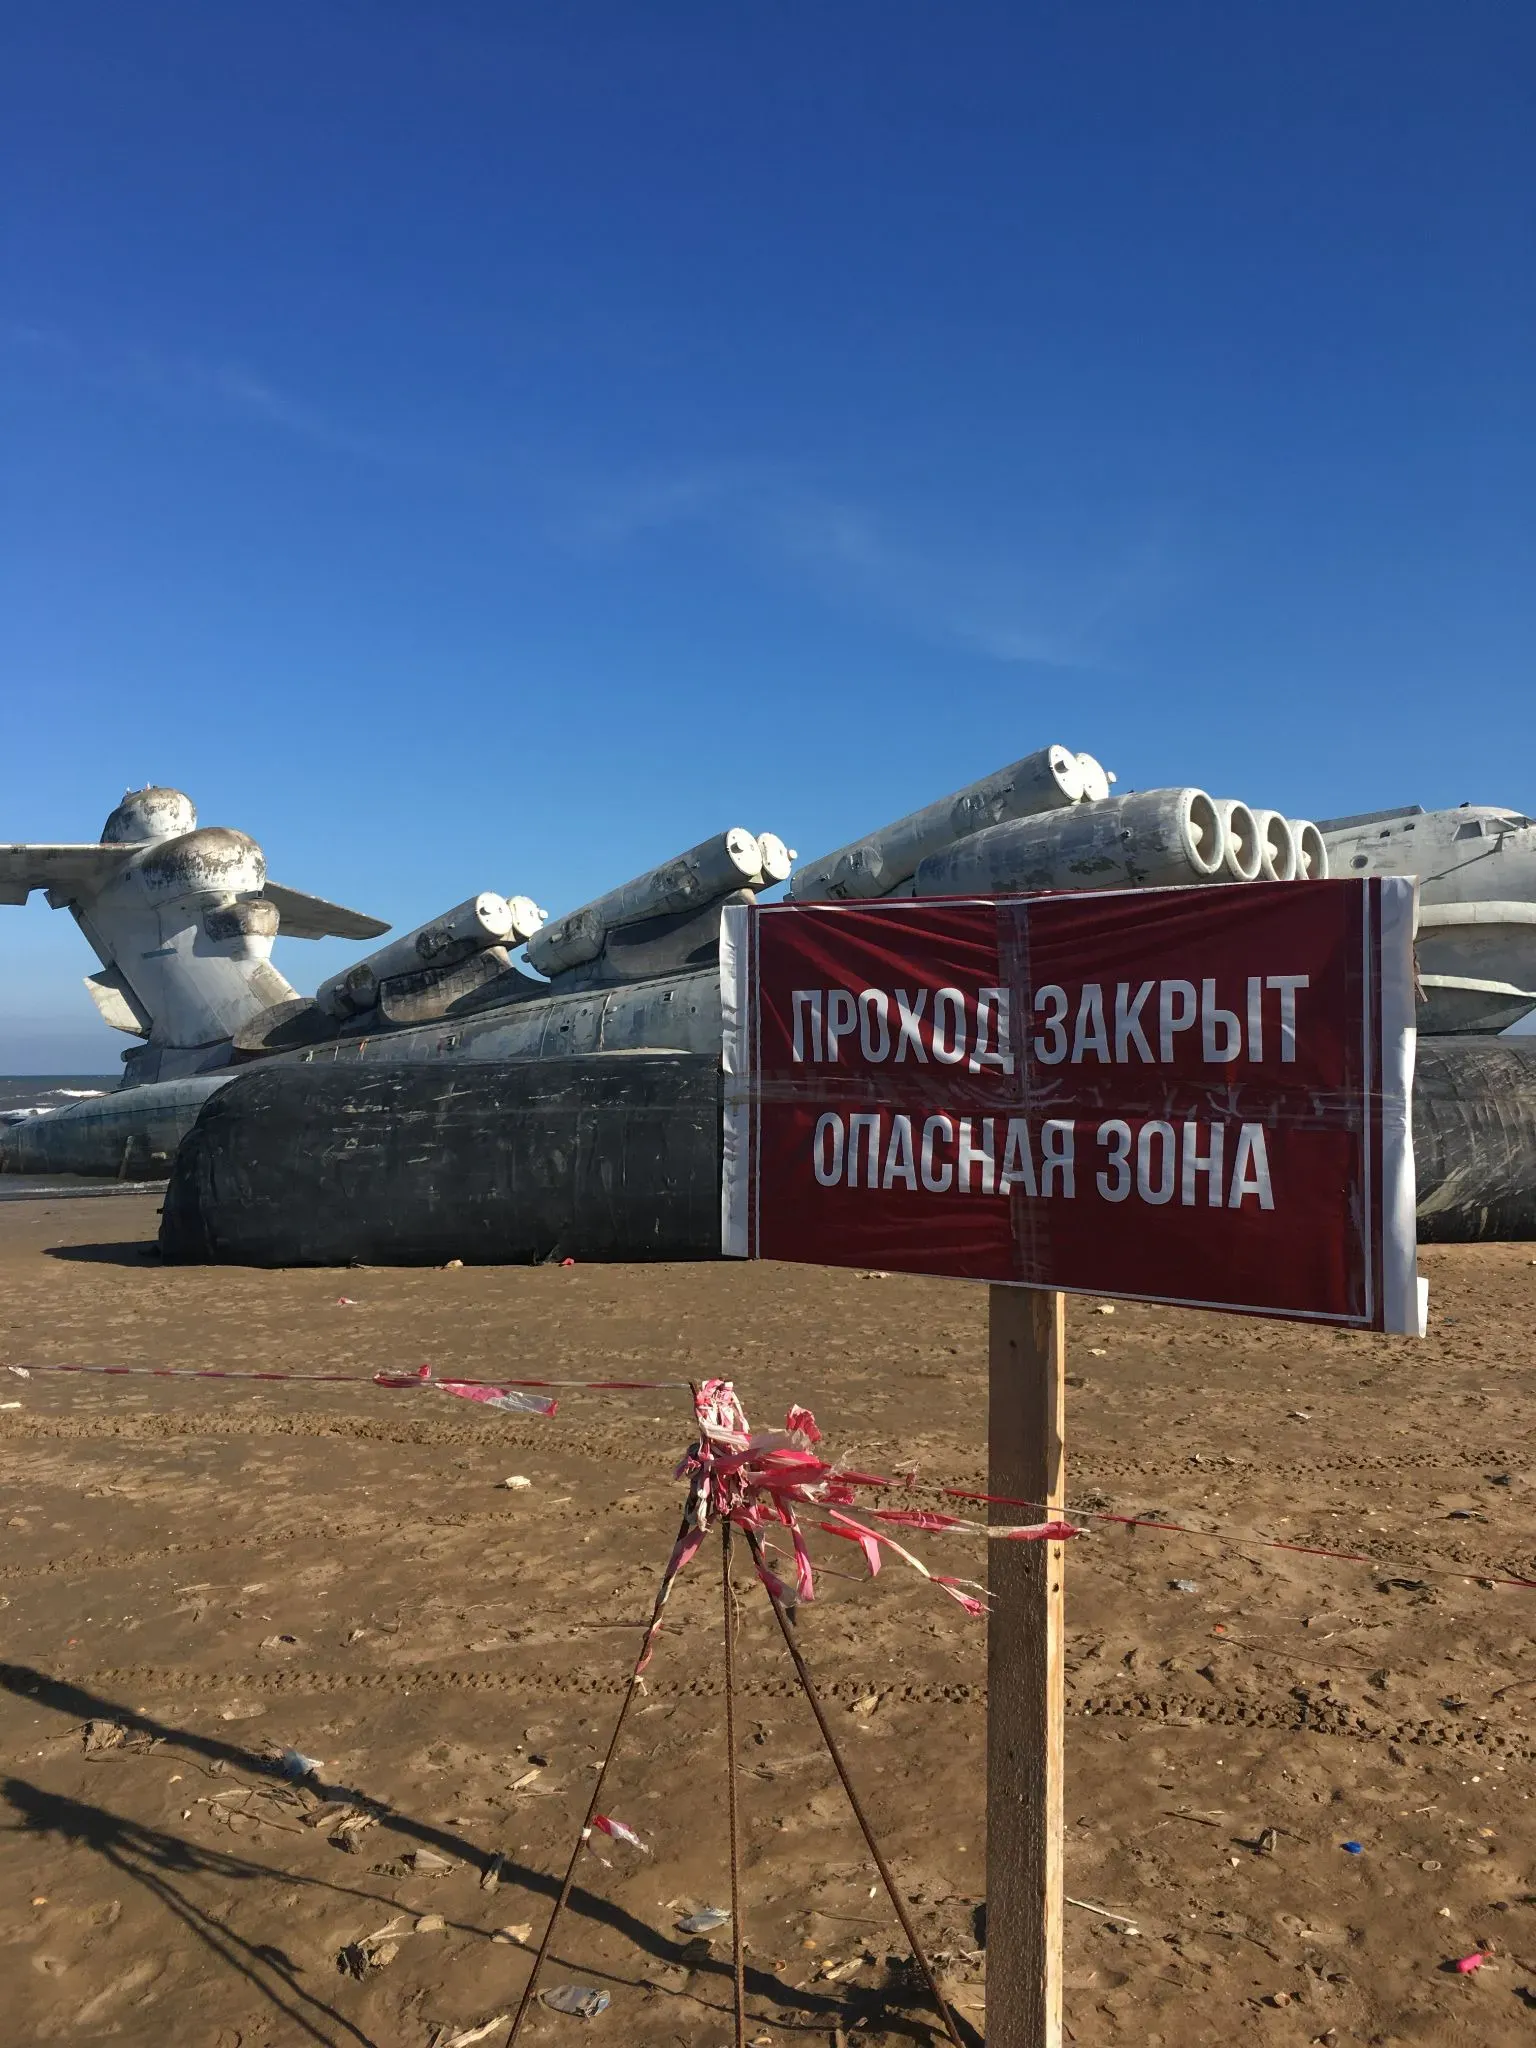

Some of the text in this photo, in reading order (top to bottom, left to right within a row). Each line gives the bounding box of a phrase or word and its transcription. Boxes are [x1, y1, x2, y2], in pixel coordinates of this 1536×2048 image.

[791, 974, 1311, 1075] ПРОХОД ЗАКРЫТ
[813, 1112, 1276, 1211] ОПАСНАЯ ЗОНА
